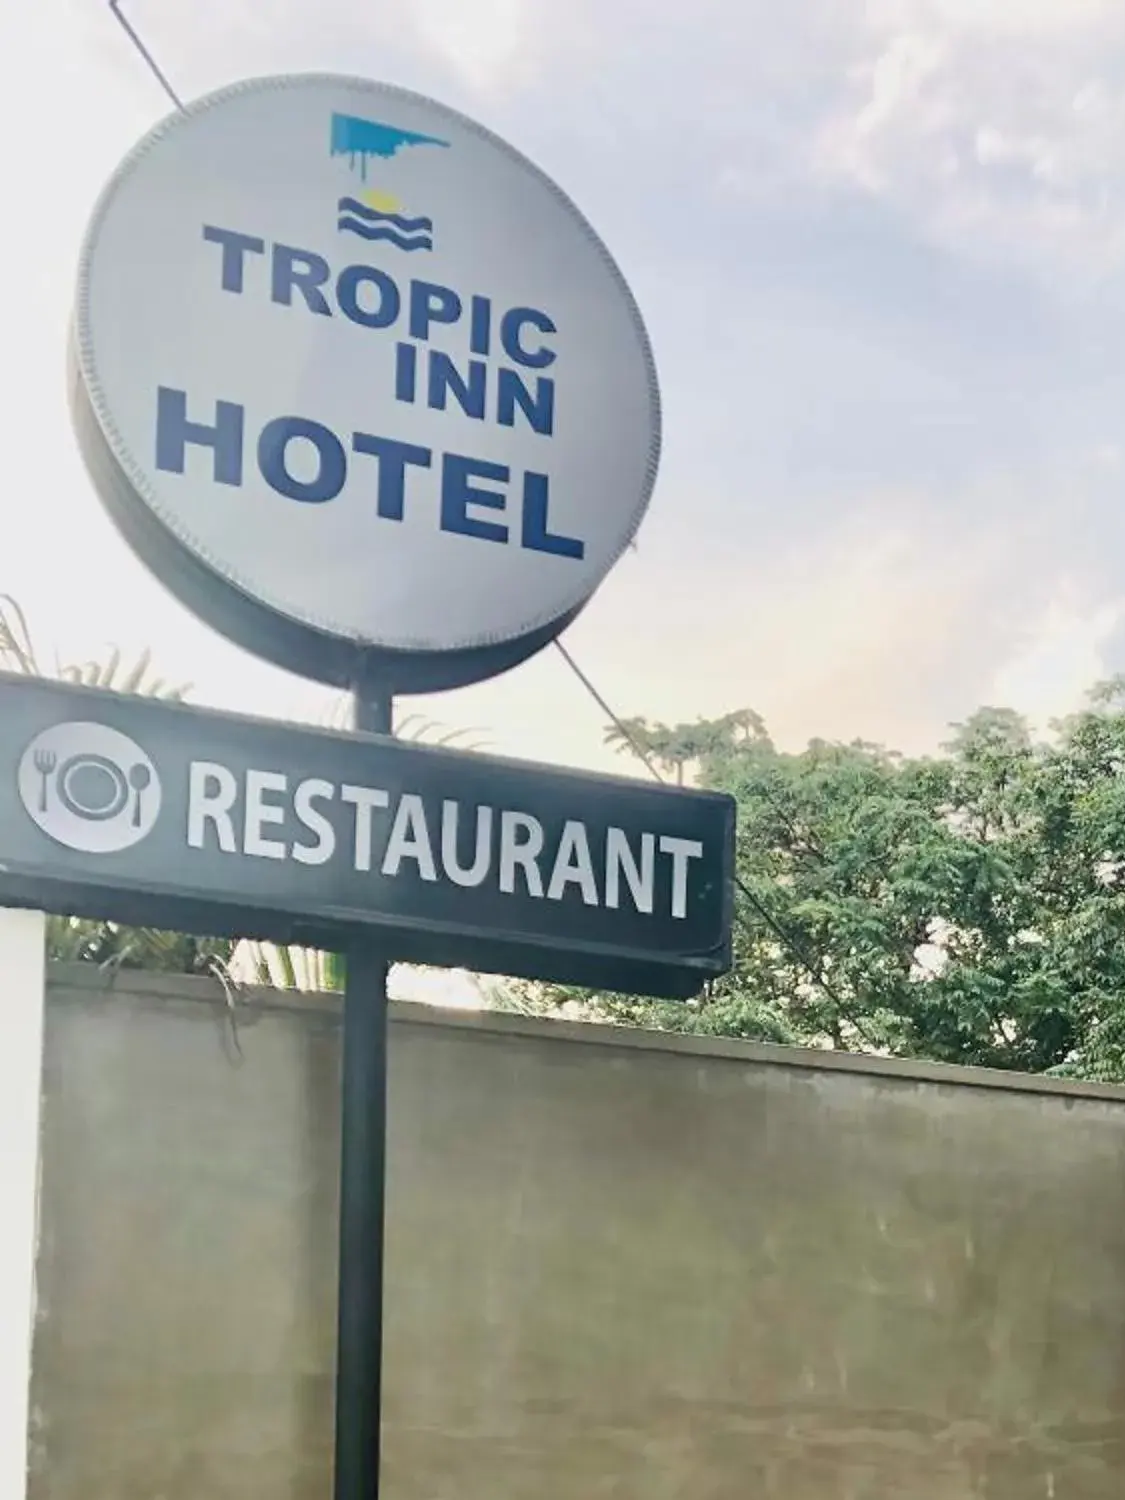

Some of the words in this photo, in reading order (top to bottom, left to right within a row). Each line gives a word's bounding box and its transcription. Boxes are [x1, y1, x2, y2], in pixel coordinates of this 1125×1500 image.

[203, 225, 559, 371] TROPIC
[394, 342, 556, 436] INN
[155, 385, 586, 560] HOTEL
[187, 760, 704, 919] RESTAURANT
